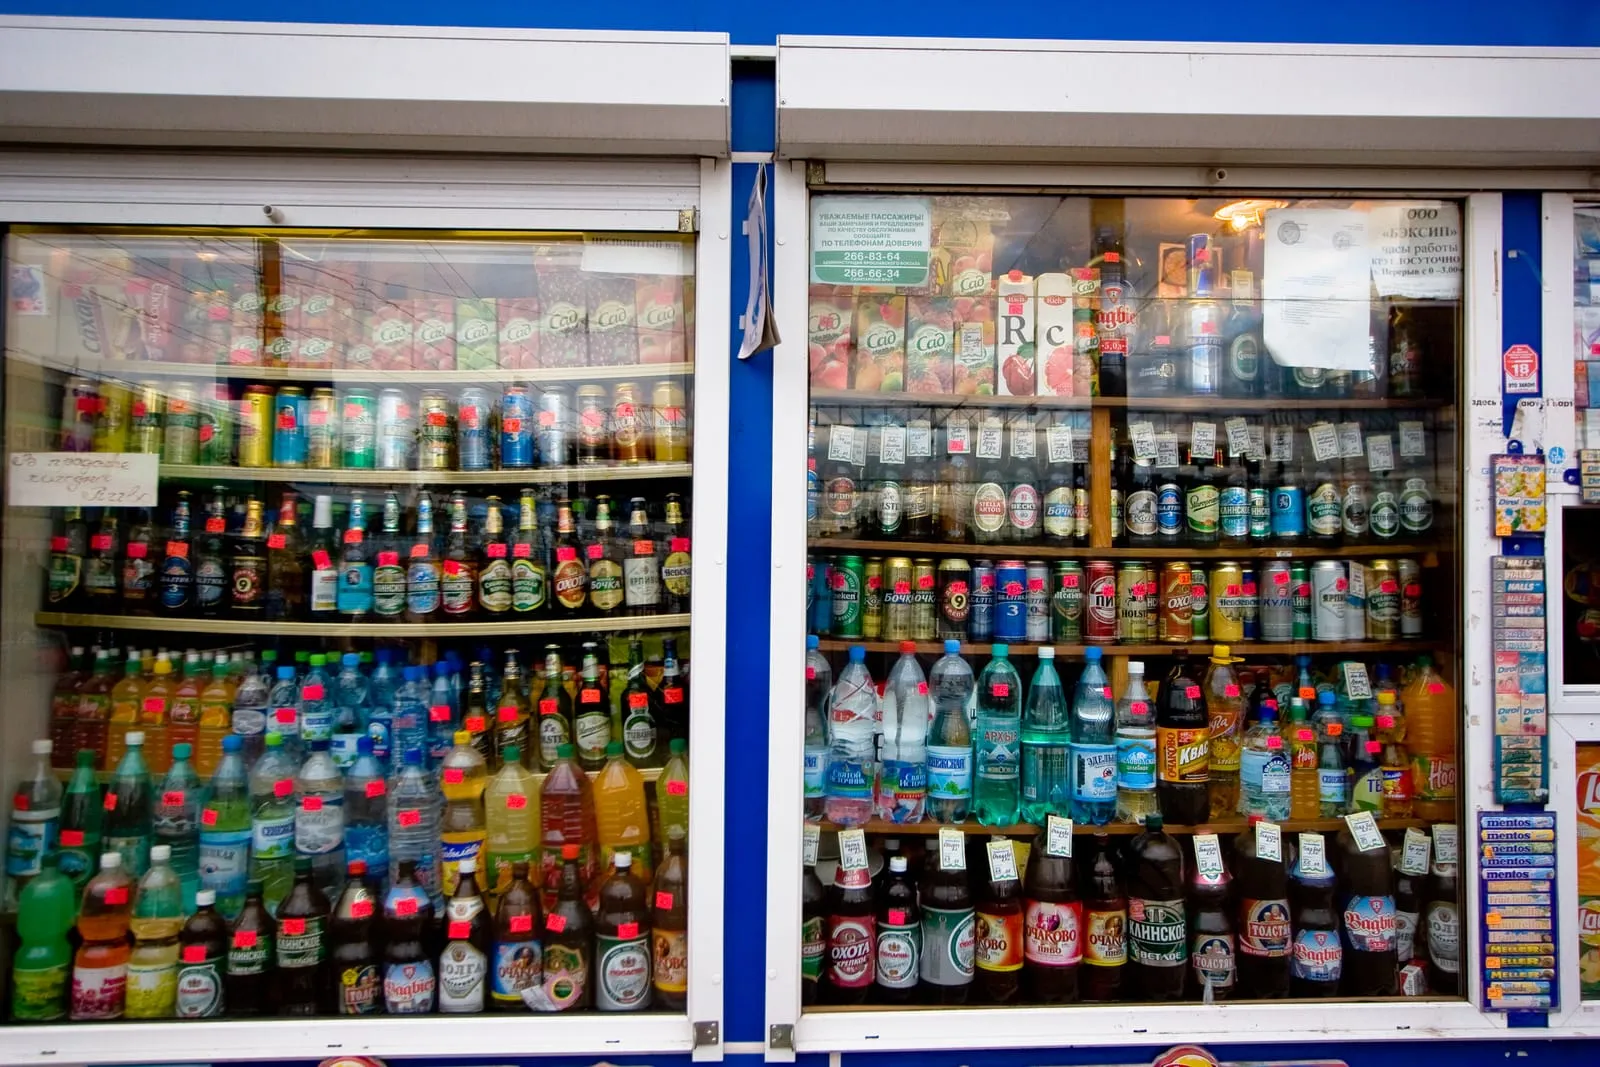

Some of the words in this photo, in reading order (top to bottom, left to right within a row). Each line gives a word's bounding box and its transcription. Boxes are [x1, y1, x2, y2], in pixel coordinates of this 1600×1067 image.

[819, 213, 869, 221] УВАЖАЕМЫЕ
[1407, 208, 1438, 220] ООО
[885, 240, 922, 248] ДОВЕРИЯ
[1414, 243, 1458, 255] работы
[844, 252, 900, 261] 266-83-64
[844, 269, 900, 278] 266-66-34
[960, 276, 984, 293] Сад
[549, 310, 578, 331] Сад
[598, 307, 627, 328] Сад
[647, 305, 676, 326] Сад
[808, 312, 841, 333] Сд
[1001, 315, 1027, 345] R
[866, 330, 896, 349] Сад
[916, 332, 947, 352] Сад
[1511, 364, 1529, 374] 18
[1507, 559, 1533, 568] HALLS
[1507, 583, 1534, 591] HALLS
[954, 594, 964, 606] 9
[1007, 605, 1019, 616] 3
[1507, 606, 1535, 615] HALLS
[984, 730, 1018, 742] АРХЫЗ
[1180, 741, 1210, 766] КВАС
[1430, 760, 1456, 791] Hoo
[1487, 819, 1531, 828] mentos
[1487, 832, 1531, 840] mentos
[1488, 858, 1532, 866] mentos
[1486, 870, 1530, 880] mentos
[1026, 928, 1076, 942] ОЧАКОВО
[1129, 920, 1186, 942] КЛИНСКОЕ
[831, 942, 870, 959] ОХОТА
[1194, 956, 1234, 969] ТОЛСТЯК
[1500, 958, 1540, 966] ELLER
